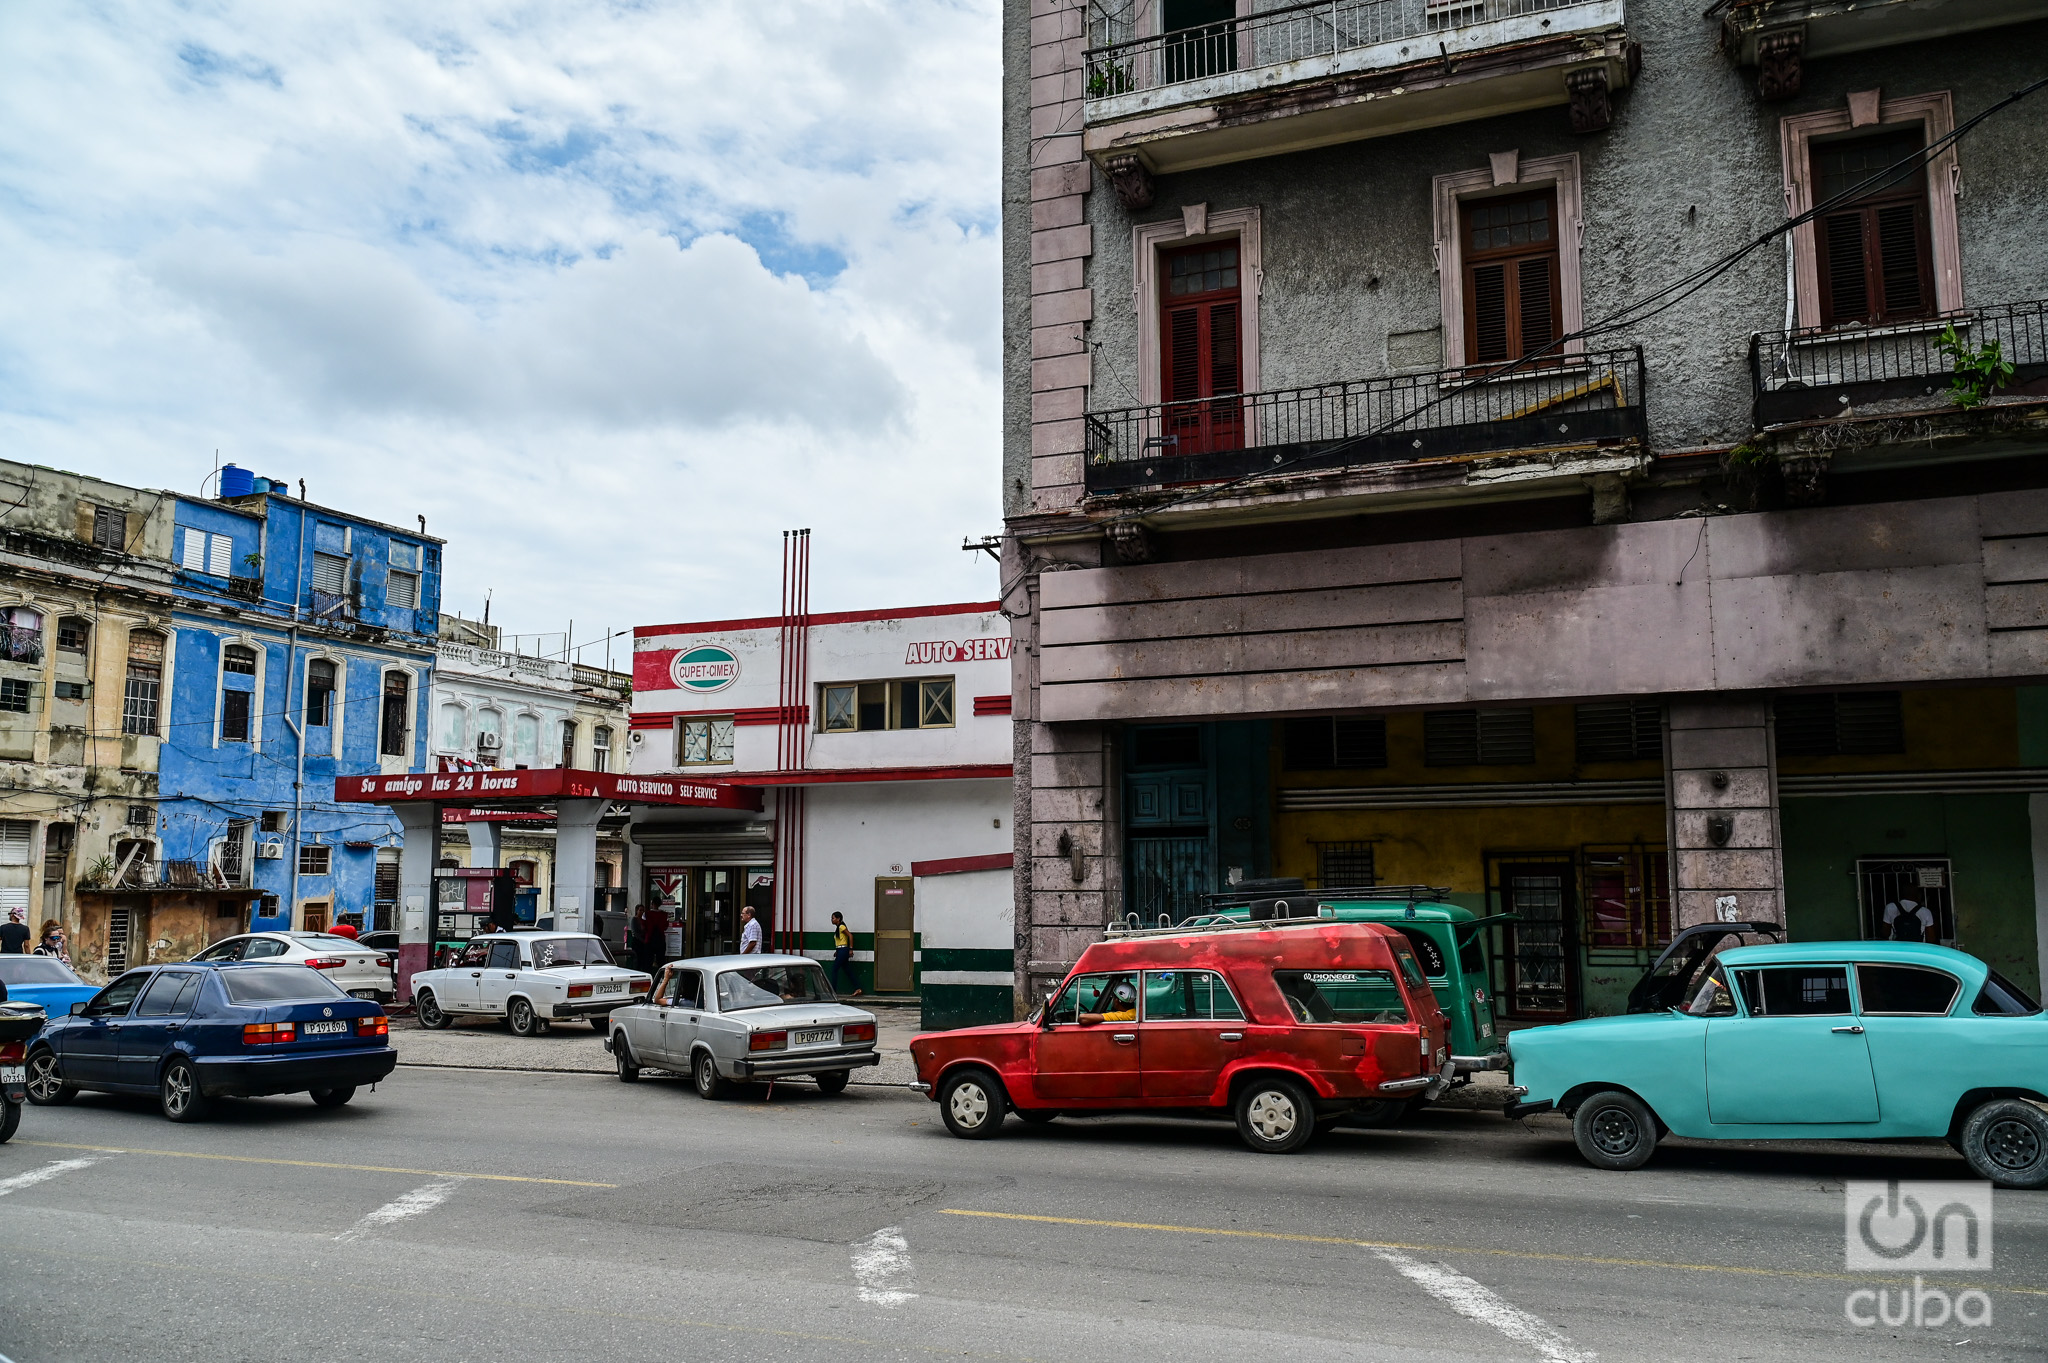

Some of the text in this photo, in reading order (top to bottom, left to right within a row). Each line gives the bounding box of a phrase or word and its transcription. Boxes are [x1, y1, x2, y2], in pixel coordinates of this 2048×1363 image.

[905, 640, 957, 665] AUTO
[680, 664, 735, 678] CUPET-CIMEX
[361, 773, 518, 795] Su amigo las 24 horas
[571, 783, 591, 797] 3.5 m
[616, 778, 718, 800] AUTO SERVICIO SELF SERVICE
